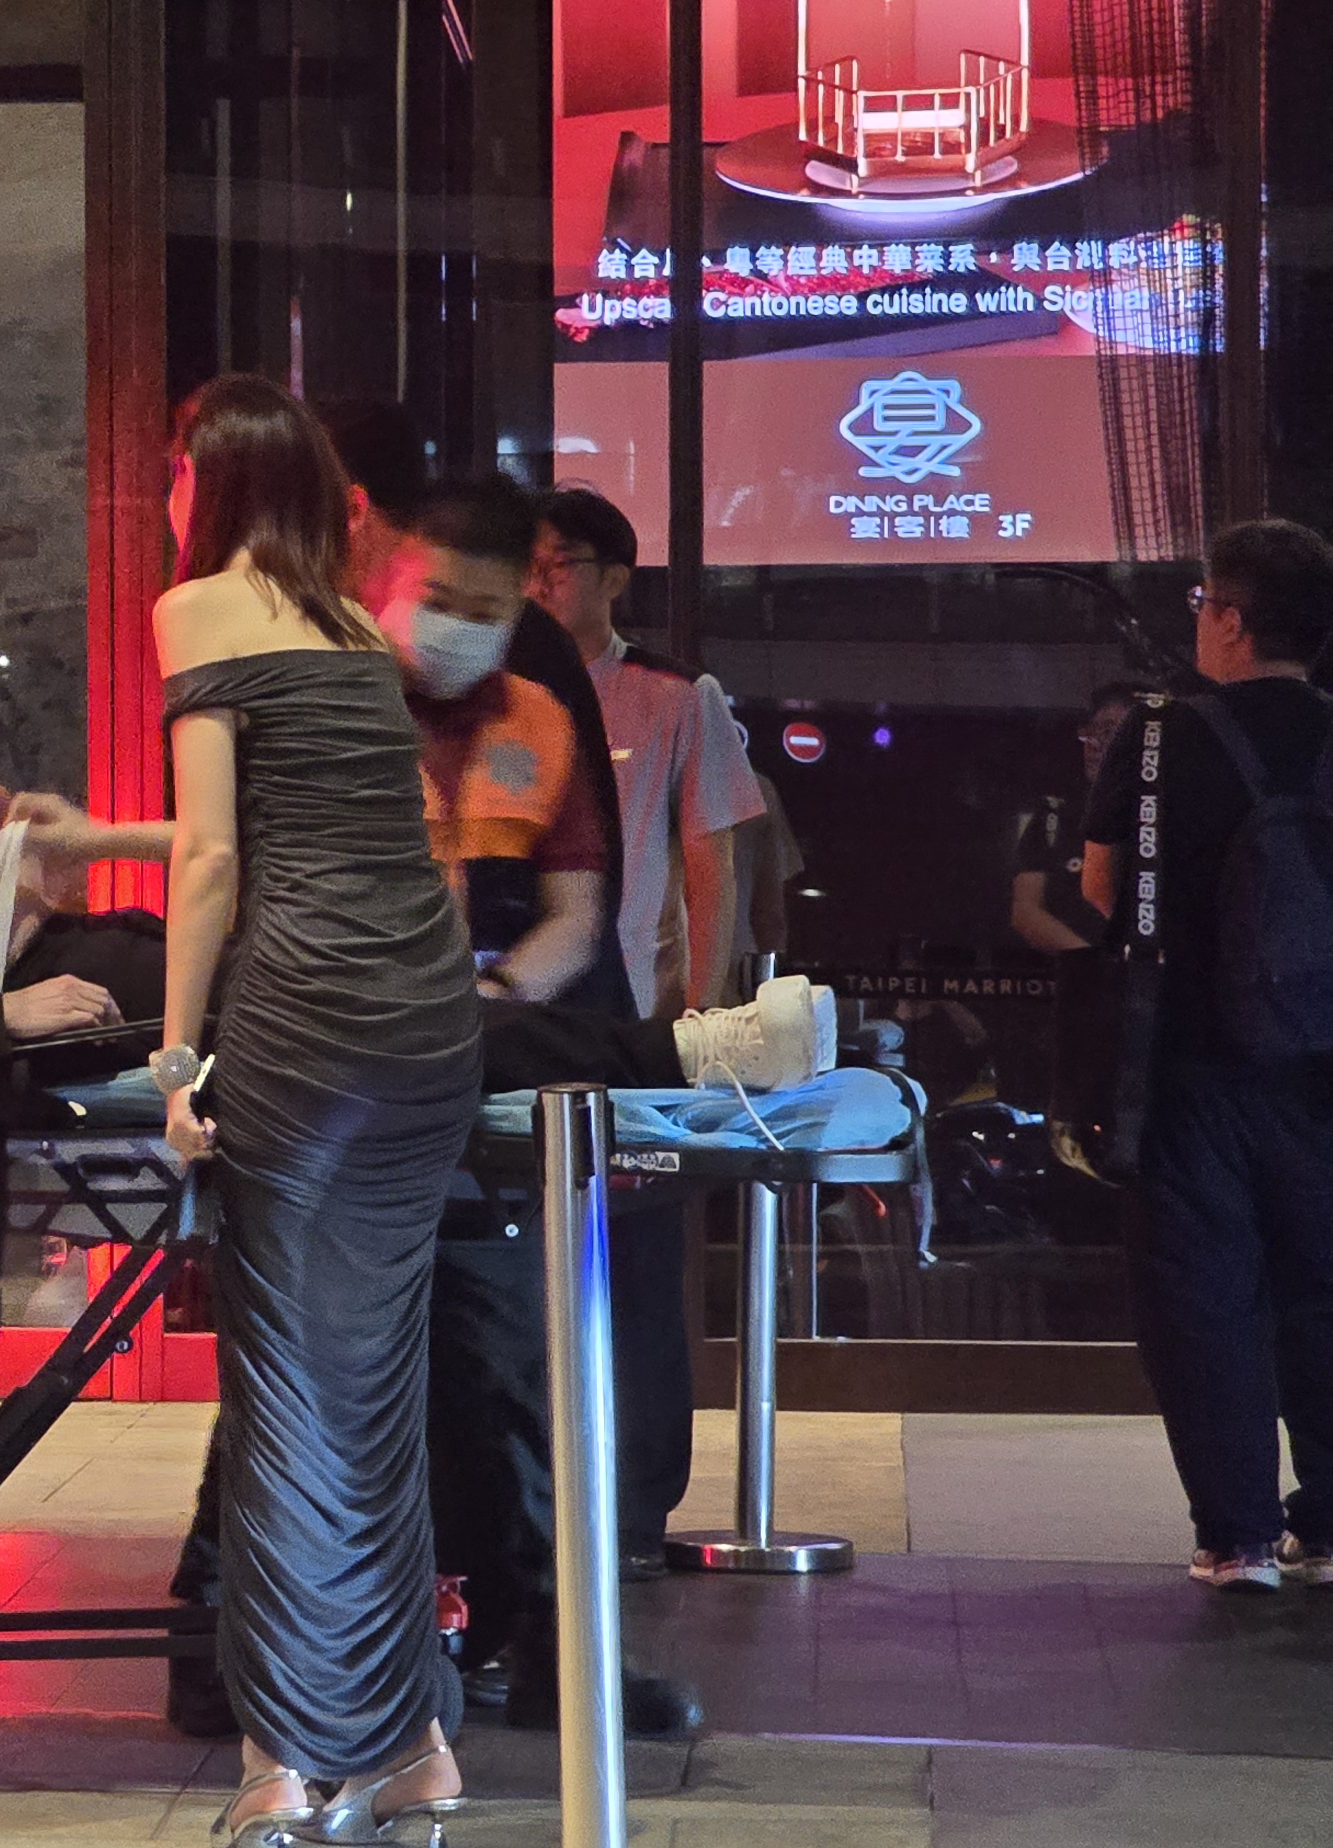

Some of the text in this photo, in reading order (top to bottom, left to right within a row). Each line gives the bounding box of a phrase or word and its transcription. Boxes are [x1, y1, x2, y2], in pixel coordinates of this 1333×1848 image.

[582, 293, 671, 325] Upsca
[703, 291, 858, 318] Cantonese
[866, 286, 968, 315] cuisine
[975, 285, 1034, 313] with
[829, 493, 991, 513] DINING PLACE
[997, 513, 1032, 538] 3F
[1141, 720, 1162, 782] KENZO
[1139, 795, 1157, 859] KENZO
[1137, 871, 1155, 936] KENZO
[845, 974, 927, 994] TAIPEI
